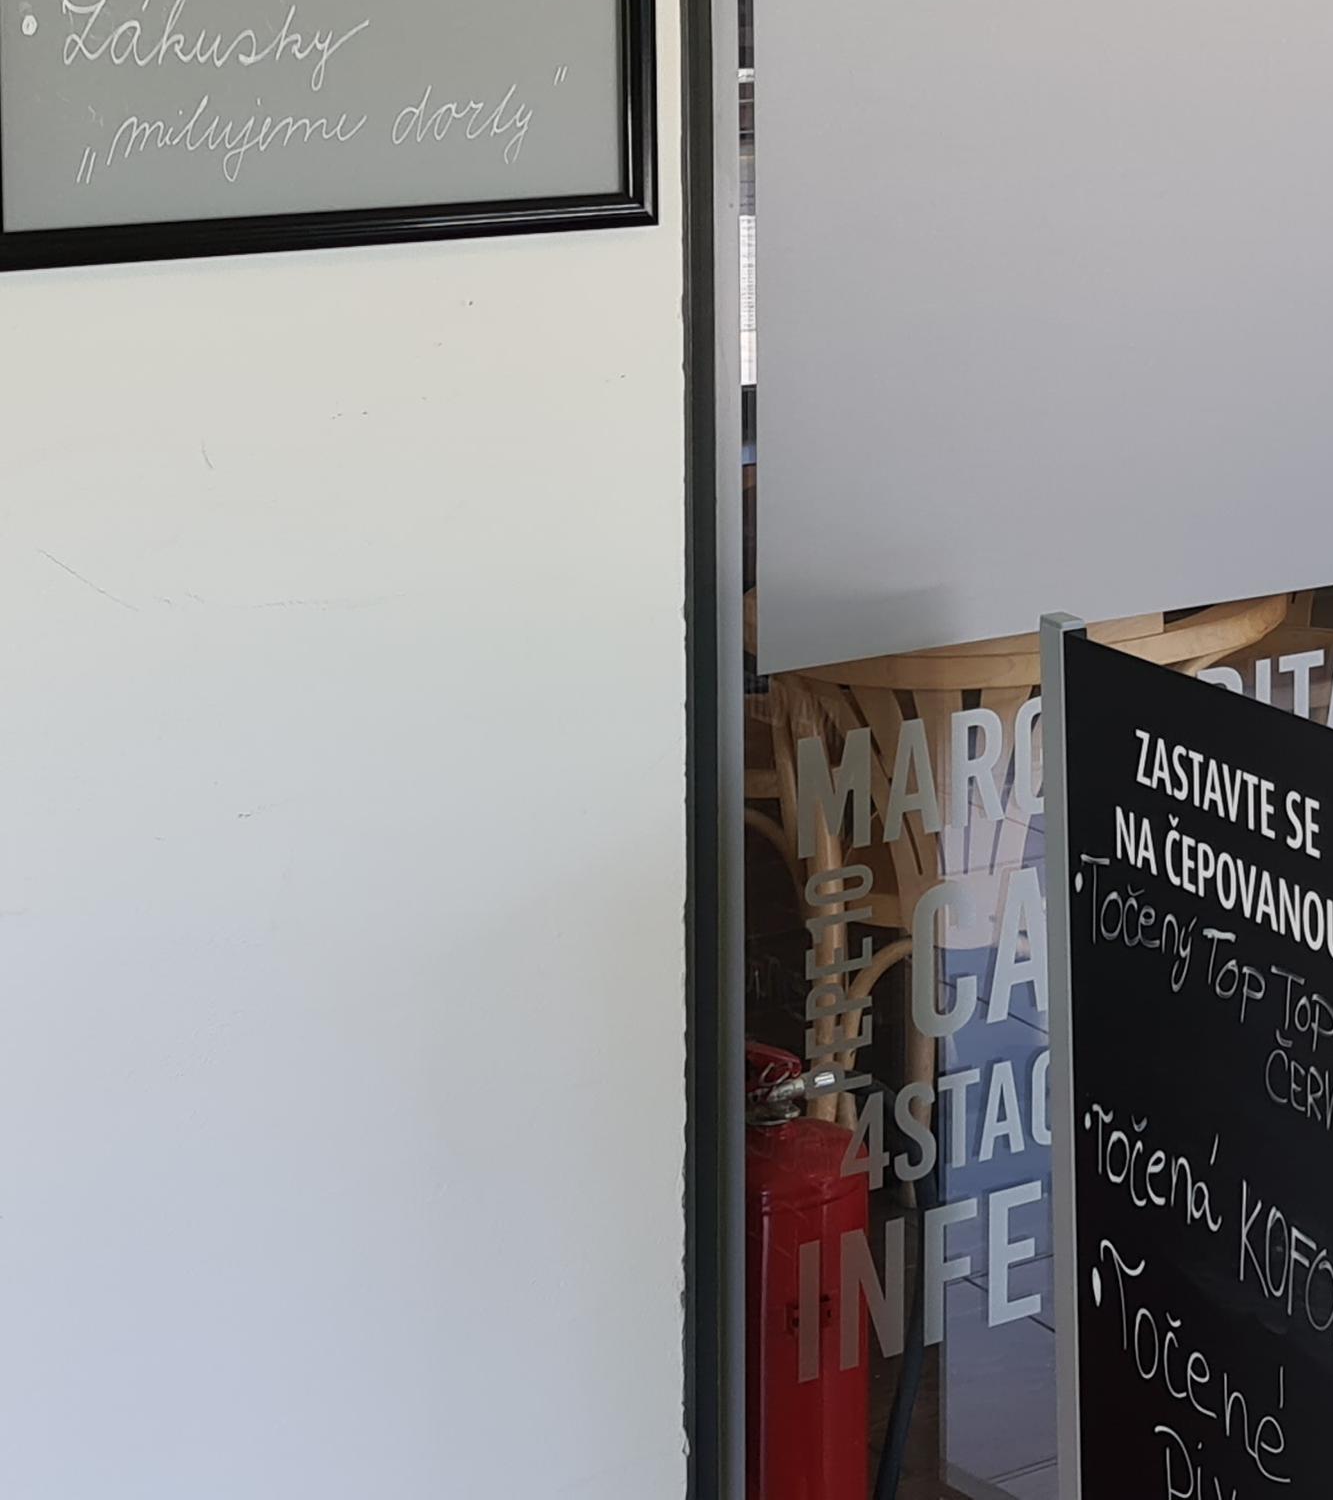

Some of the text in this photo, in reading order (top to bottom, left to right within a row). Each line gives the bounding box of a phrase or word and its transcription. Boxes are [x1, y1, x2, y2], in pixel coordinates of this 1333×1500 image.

[1134, 729, 1322, 860] ZASTAVTE SE
[1114, 806, 1158, 877] NA
[1154, 1425, 1238, 1500] Piv
